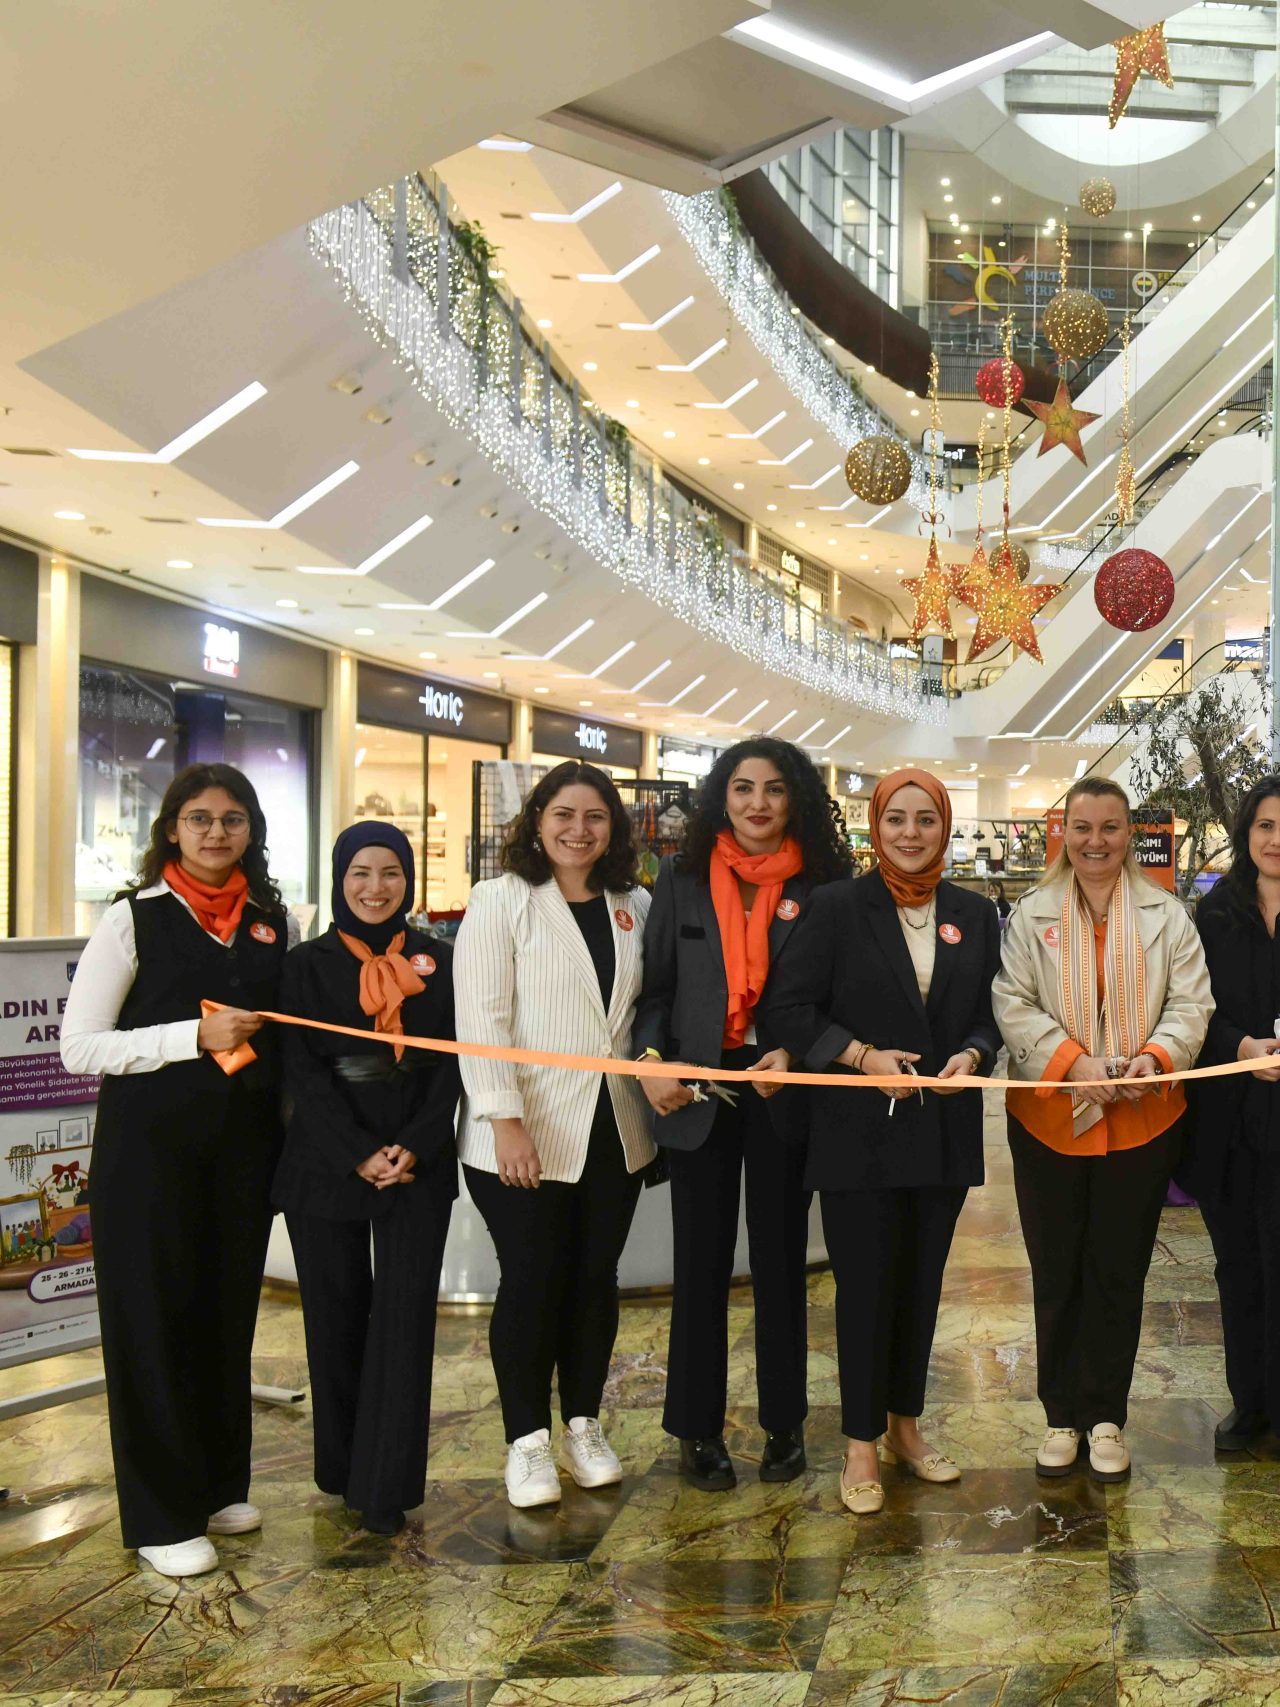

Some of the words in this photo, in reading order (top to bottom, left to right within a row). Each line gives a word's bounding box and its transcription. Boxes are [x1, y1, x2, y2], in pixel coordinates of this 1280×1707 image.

[57, 997, 68, 1015] E
[25, 1025, 60, 1044] AR
[41, 1274, 52, 1282] 25
[75, 1267, 85, 1275] 27
